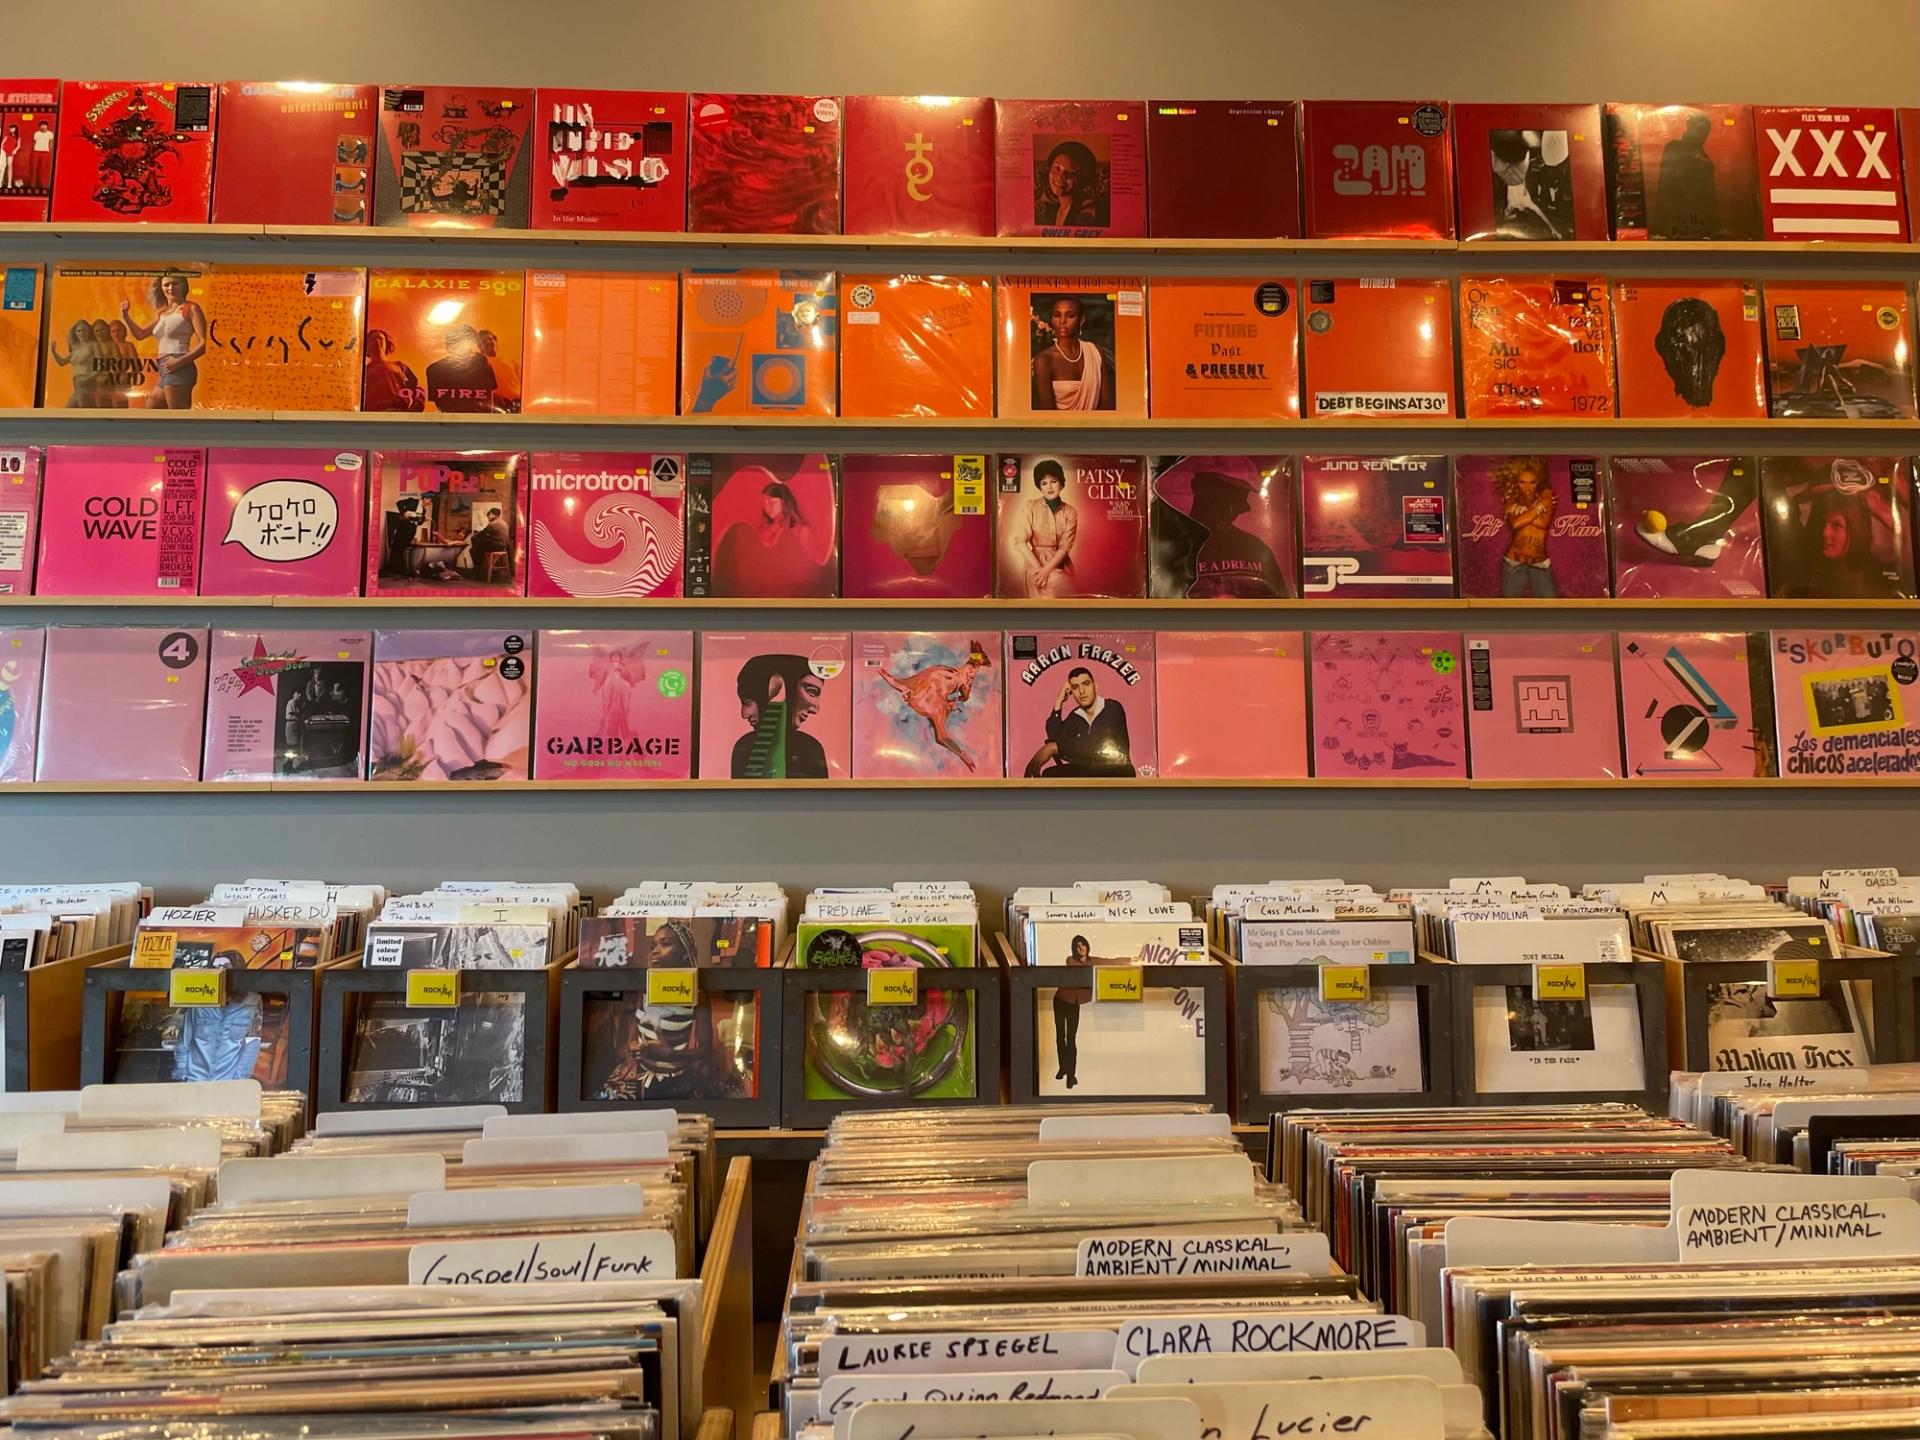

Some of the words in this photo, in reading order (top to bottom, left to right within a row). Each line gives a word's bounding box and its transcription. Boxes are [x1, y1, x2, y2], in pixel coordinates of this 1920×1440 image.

[1802, 114, 1815, 122] FLEX
[374, 278, 470, 290] GALAXIE
[999, 276, 1072, 288] WHITNEY
[1078, 277, 1142, 288] HOUSTON
[1194, 324, 1258, 338] FUTURE
[1489, 343, 1520, 356] Mu
[92, 358, 160, 372] BROWN
[1185, 363, 1199, 379] &
[1200, 364, 1269, 379] PRESENT
[437, 389, 487, 399] FIRE
[1571, 395, 1608, 411] 1972
[168, 460, 197, 468] COLD
[1321, 461, 1359, 471] JUNO
[1361, 461, 1428, 471] REACTOR
[167, 469, 197, 477] WAVE
[1077, 469, 1125, 484] PATSY
[1088, 485, 1137, 500] CLINE
[84, 497, 158, 517] COLD
[247, 499, 316, 522] ケロケロ
[83, 520, 157, 541] WAVE
[1549, 515, 1603, 538] Kim
[159, 563, 193, 571] BROKEN
[1221, 560, 1263, 572] DREAM
[162, 637, 190, 661] 4
[1778, 633, 1914, 663] ESKORBUTO
[1021, 644, 1072, 685] AARON
[1079, 643, 1142, 686] FRAZER
[546, 737, 680, 755] GARBAGE
[1822, 728, 1920, 752] demenciales
[1820, 878, 1829, 889] N
[1865, 878, 1897, 887] OASIS
[327, 891, 337, 903] H
[1050, 891, 1058, 904] L
[1104, 890, 1133, 902] M83
[1651, 891, 1669, 904] M
[162, 909, 217, 923] HOZIER
[248, 903, 302, 919] HÜSKER
[819, 905, 848, 917] FRED
[851, 904, 883, 915] LANE
[1109, 907, 1137, 917] NICK
[1149, 906, 1175, 915] LOWE
[1260, 906, 1280, 915] Cass
[1461, 912, 1490, 922] TONY
[1492, 911, 1528, 920] MOLINA
[1877, 906, 1901, 914] NICO
[389, 913, 408, 921] The
[410, 913, 432, 921] Jam
[1307, 928, 1340, 936] McCombs
[141, 936, 172, 952] HOZIER
[376, 937, 402, 945] limited
[1248, 939, 1262, 948] Sing
[1265, 939, 1277, 947] and
[1279, 940, 1293, 948] Play
[1295, 939, 1310, 947] New
[1329, 938, 1350, 948] Songs
[1352, 938, 1361, 946] for
[1363, 938, 1391, 946] Children
[377, 955, 398, 963] vinyl
[1141, 943, 1181, 965] NICK
[1779, 1075, 1816, 1088] Holter
[1689, 1204, 1766, 1226] MODERN
[1087, 1239, 1173, 1259] MODERN
[1125, 1322, 1212, 1356] CLARA
[1231, 1319, 1408, 1352] ROCKMORE
[837, 1341, 932, 1370] LAURIE
[946, 1333, 1059, 1358] SPIEGEL
[1250, 1404, 1371, 1440] Lucier
